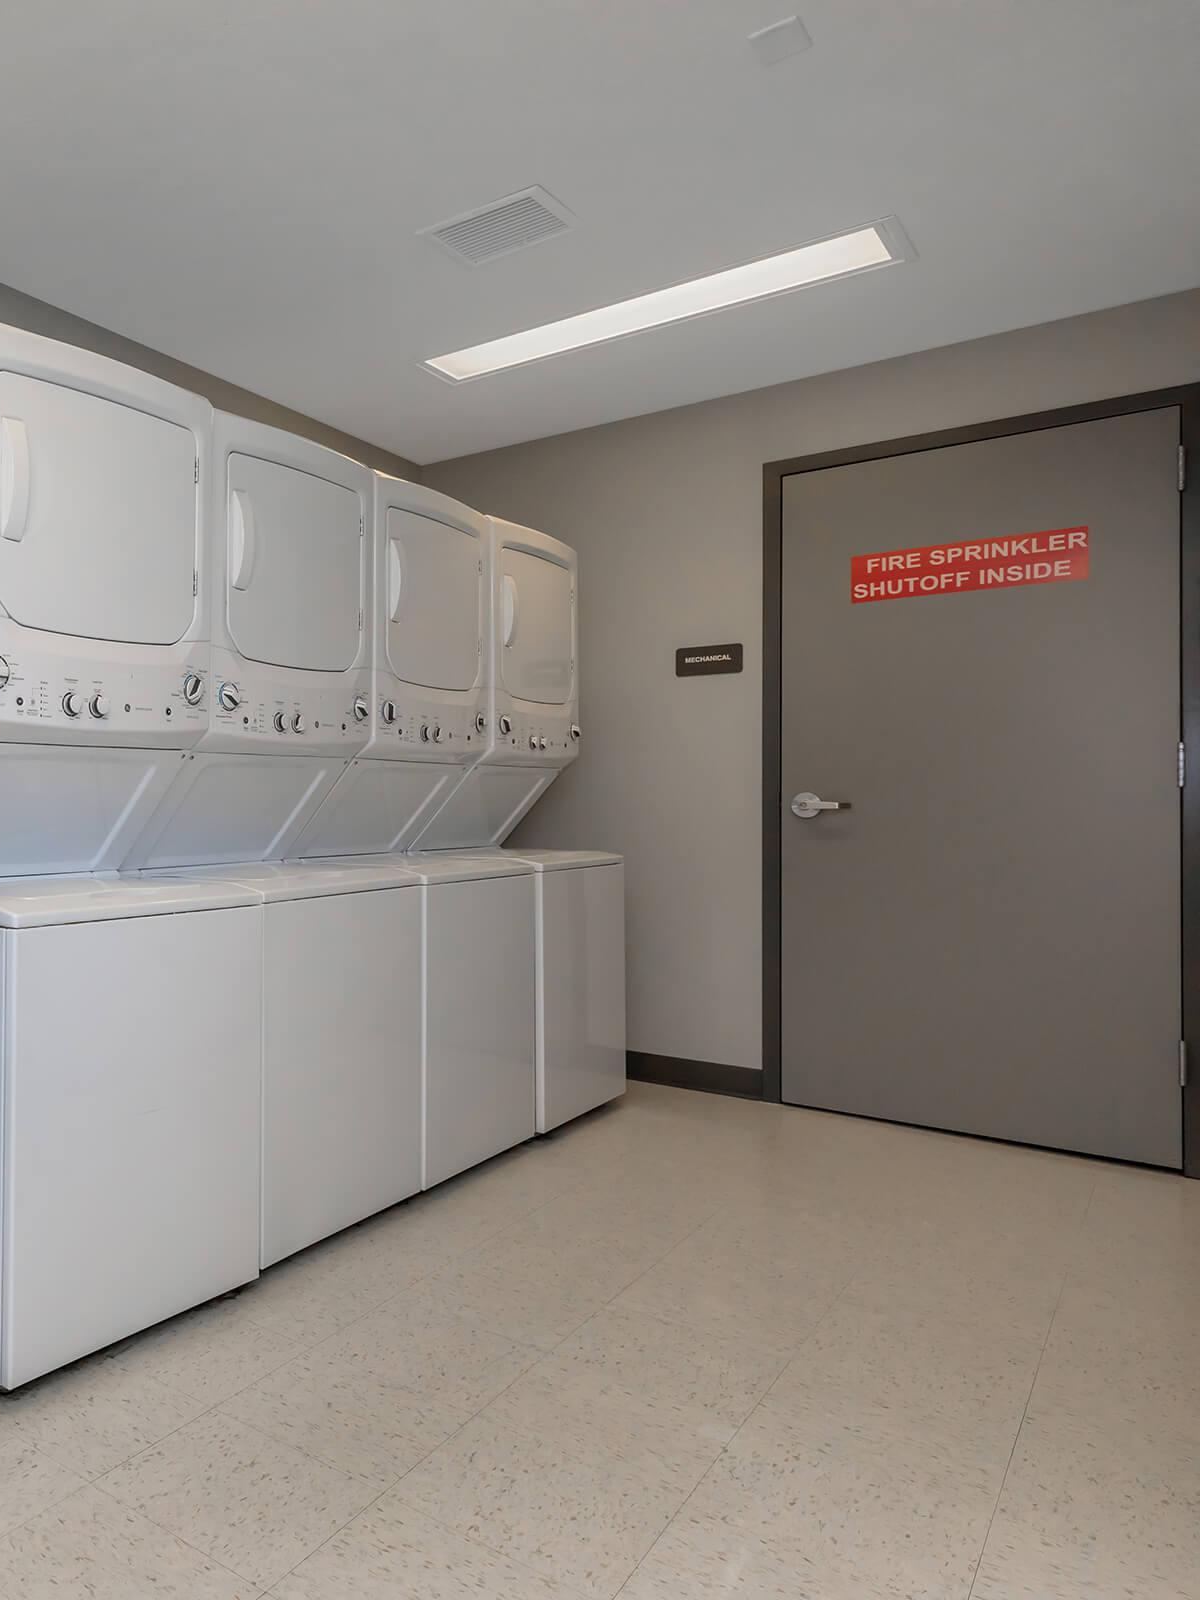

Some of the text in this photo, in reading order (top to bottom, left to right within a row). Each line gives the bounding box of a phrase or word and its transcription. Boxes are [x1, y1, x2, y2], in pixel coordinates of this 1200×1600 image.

[866, 532, 1088, 574] FIRE SPRINKLER
[853, 560, 1072, 599] SHUTOFF INSIDE
[684, 654, 732, 663] MECHANICAL
